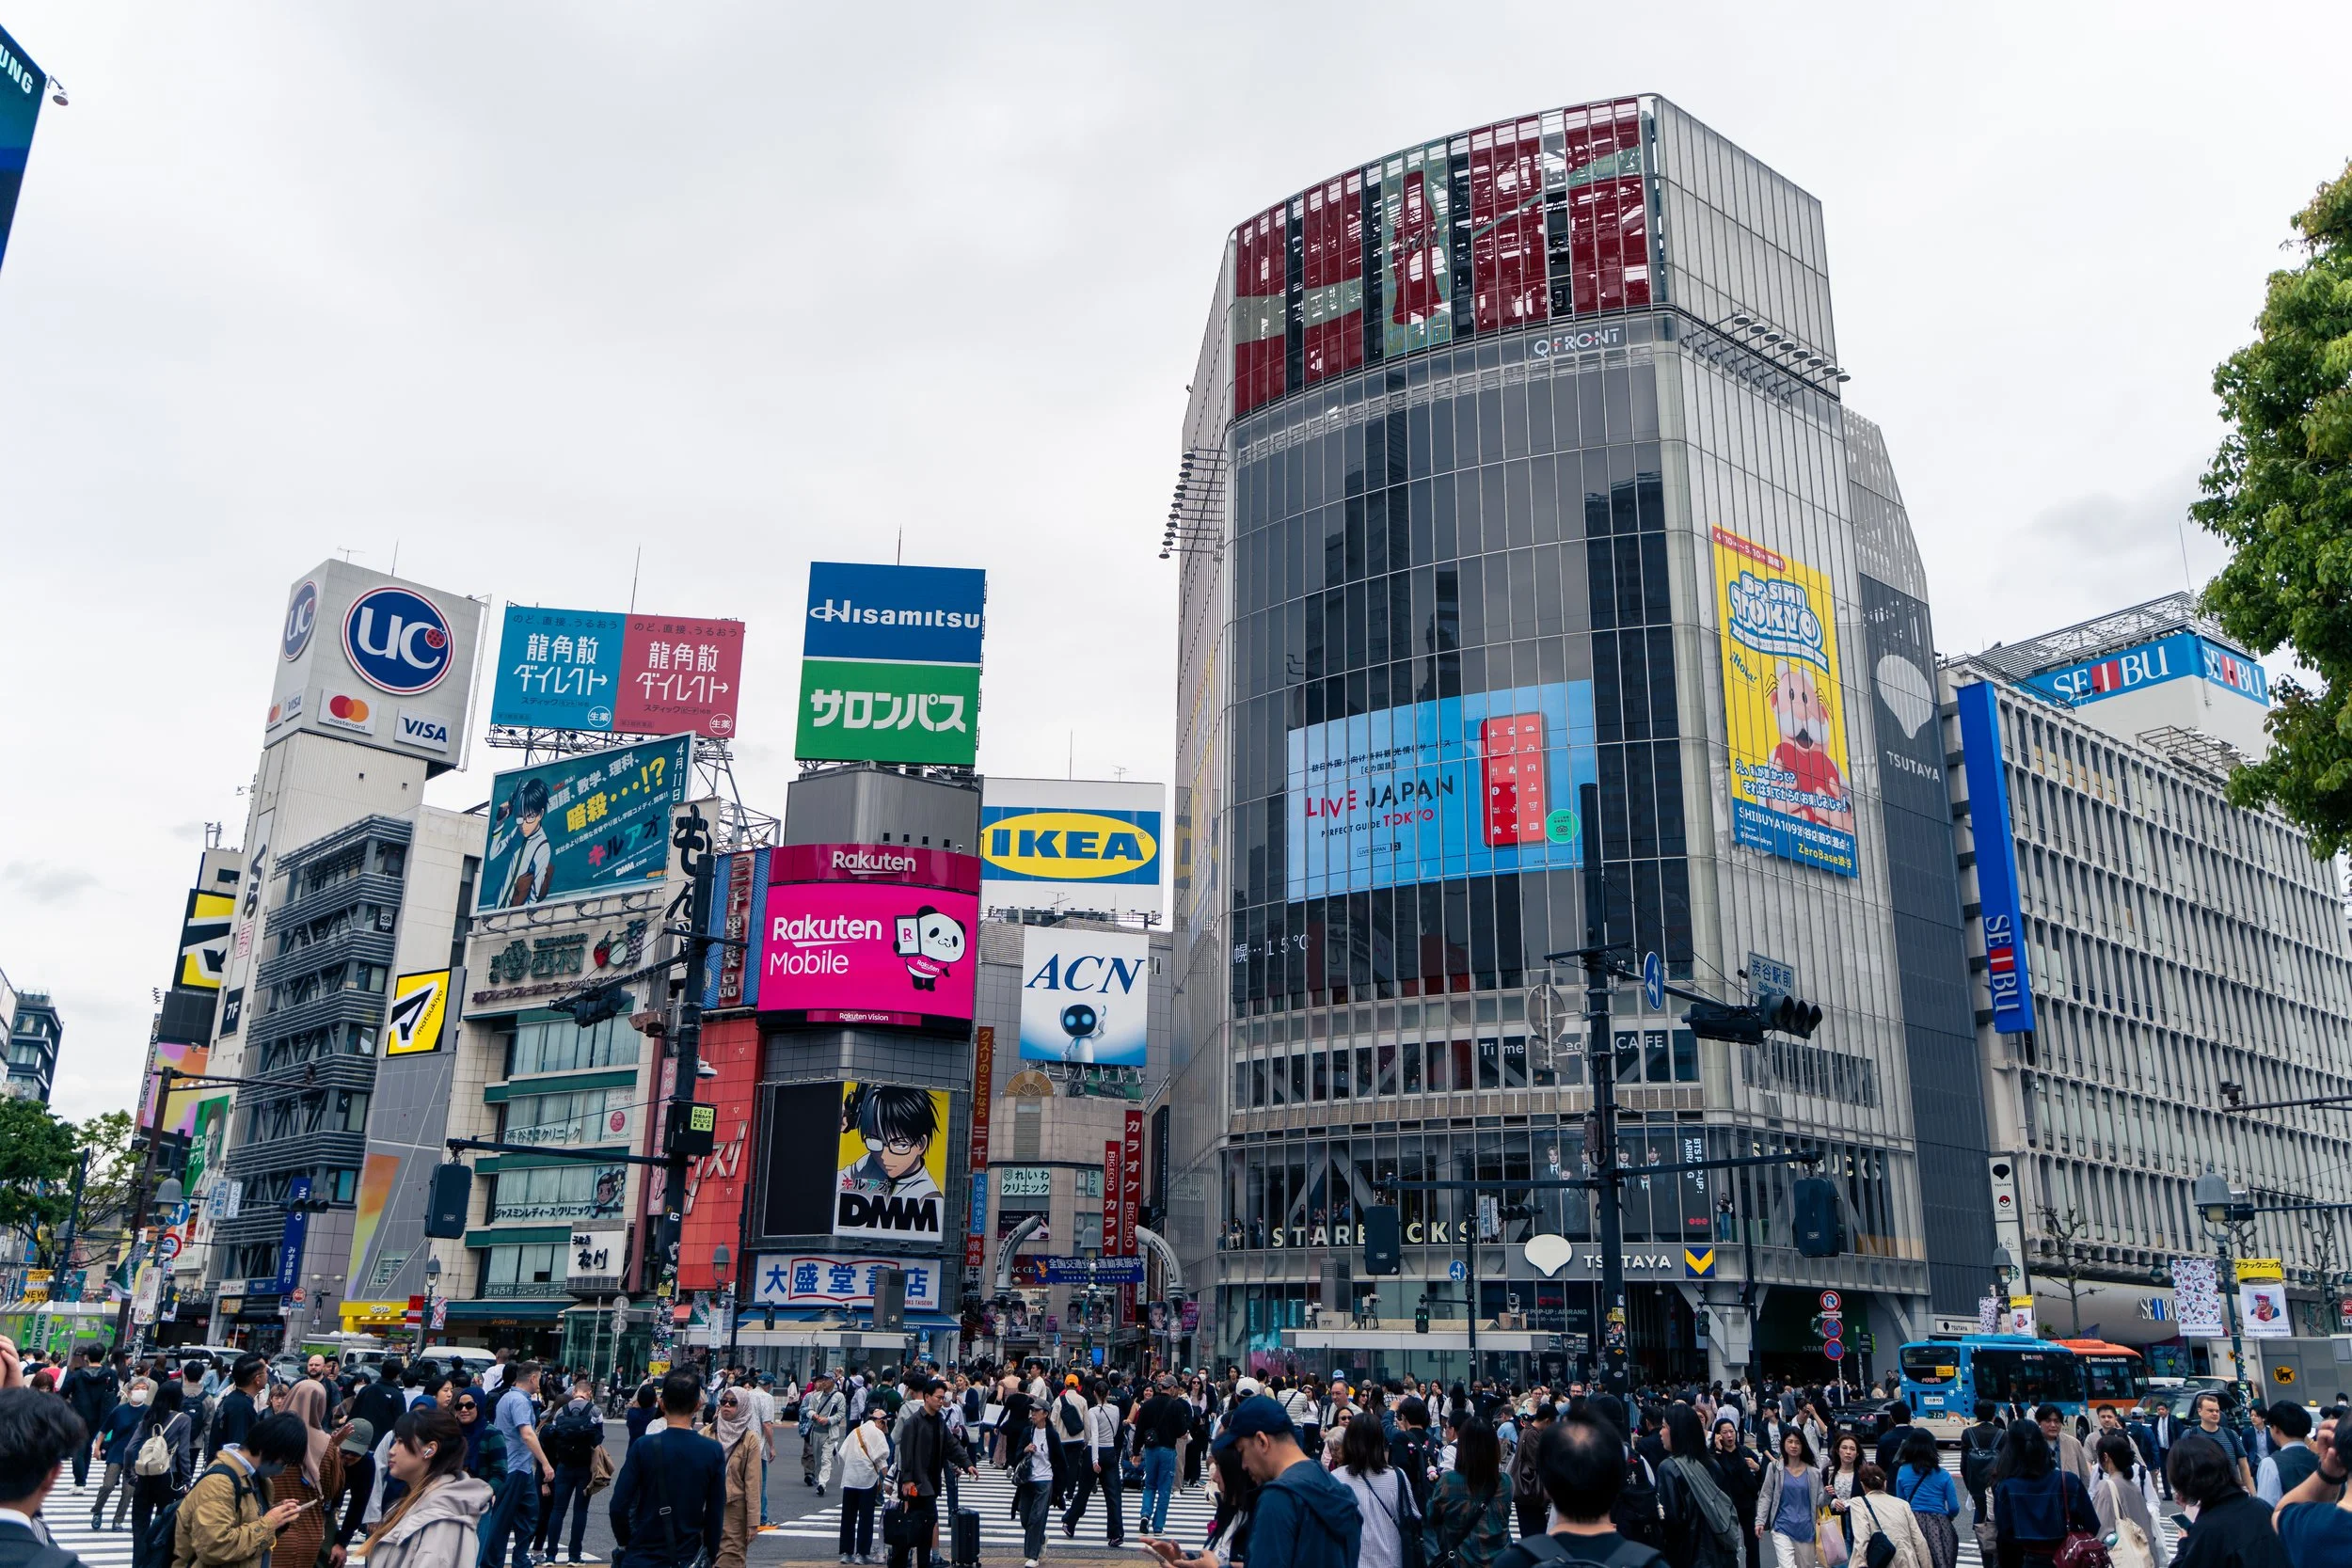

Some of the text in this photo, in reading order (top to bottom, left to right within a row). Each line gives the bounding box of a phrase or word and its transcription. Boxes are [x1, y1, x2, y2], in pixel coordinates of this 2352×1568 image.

[1534, 327, 1620, 358] QFRONT
[1769, 584, 1803, 607] SIMI
[513, 614, 618, 630] のど、直接、うるおう
[809, 599, 980, 628] Hisamitsu
[1733, 585, 1819, 639] TOKYO
[358, 607, 441, 669] UC
[634, 622, 738, 638] のど、直接、うるおう
[526, 633, 599, 665] 龍角散
[648, 641, 720, 673] 龍角散
[513, 664, 608, 696] ダイレクト
[636, 672, 729, 704] ダイレクト
[2054, 645, 2172, 705] SEIBU
[2203, 647, 2264, 700] SEIBU
[287, 695, 301, 712] VISA
[810, 689, 966, 734] サロンパス
[328, 718, 366, 731] mastercard
[402, 717, 448, 743] VISA
[1886, 751, 1940, 783] TSUTAYA
[1306, 775, 1454, 818] LIVE JAPAN
[1384, 808, 1434, 828] TOKYO
[588, 814, 660, 866] キルアオ
[992, 829, 1144, 861] IKEA
[833, 850, 916, 874] Rakuten
[773, 914, 882, 942] Rakuten
[770, 949, 850, 975] Mobile
[916, 959, 940, 974] Rakuten
[1025, 954, 1146, 994] ACN
[1752, 959, 1791, 989] 渋谷駅前
[1985, 914, 2019, 1012] SEIBU
[227, 1002, 239, 1021] 7F
[416, 989, 444, 1037] matsukiyo
[839, 1012, 866, 1021] Rakuten
[1615, 1035, 1663, 1050] CAFE
[977, 1031, 992, 1118] クスリのことなら
[189, 1149, 205, 1165] サプリ
[1106, 1150, 1116, 1192] BIG ECHO
[1125, 1120, 1140, 1192] カラオケ
[1685, 1138, 1694, 1180] ARIRG
[1693, 1138, 1705, 1189] BTS PP-UP
[1753, 1142, 1882, 1181] STABUCKS
[841, 1177, 891, 1194] キルアオ
[1003, 1183, 1049, 1194] クリニック
[1015, 1170, 1050, 1180] れいわ
[837, 1192, 939, 1233] DMM
[1125, 1202, 1135, 1248] BIG ECHO
[1272, 1221, 1475, 1247] STARCKS
[283, 1246, 295, 1284] みずほ銀行
[968, 1241, 981, 1264] 焼肉
[1583, 1254, 1673, 1270] TSTAYA
